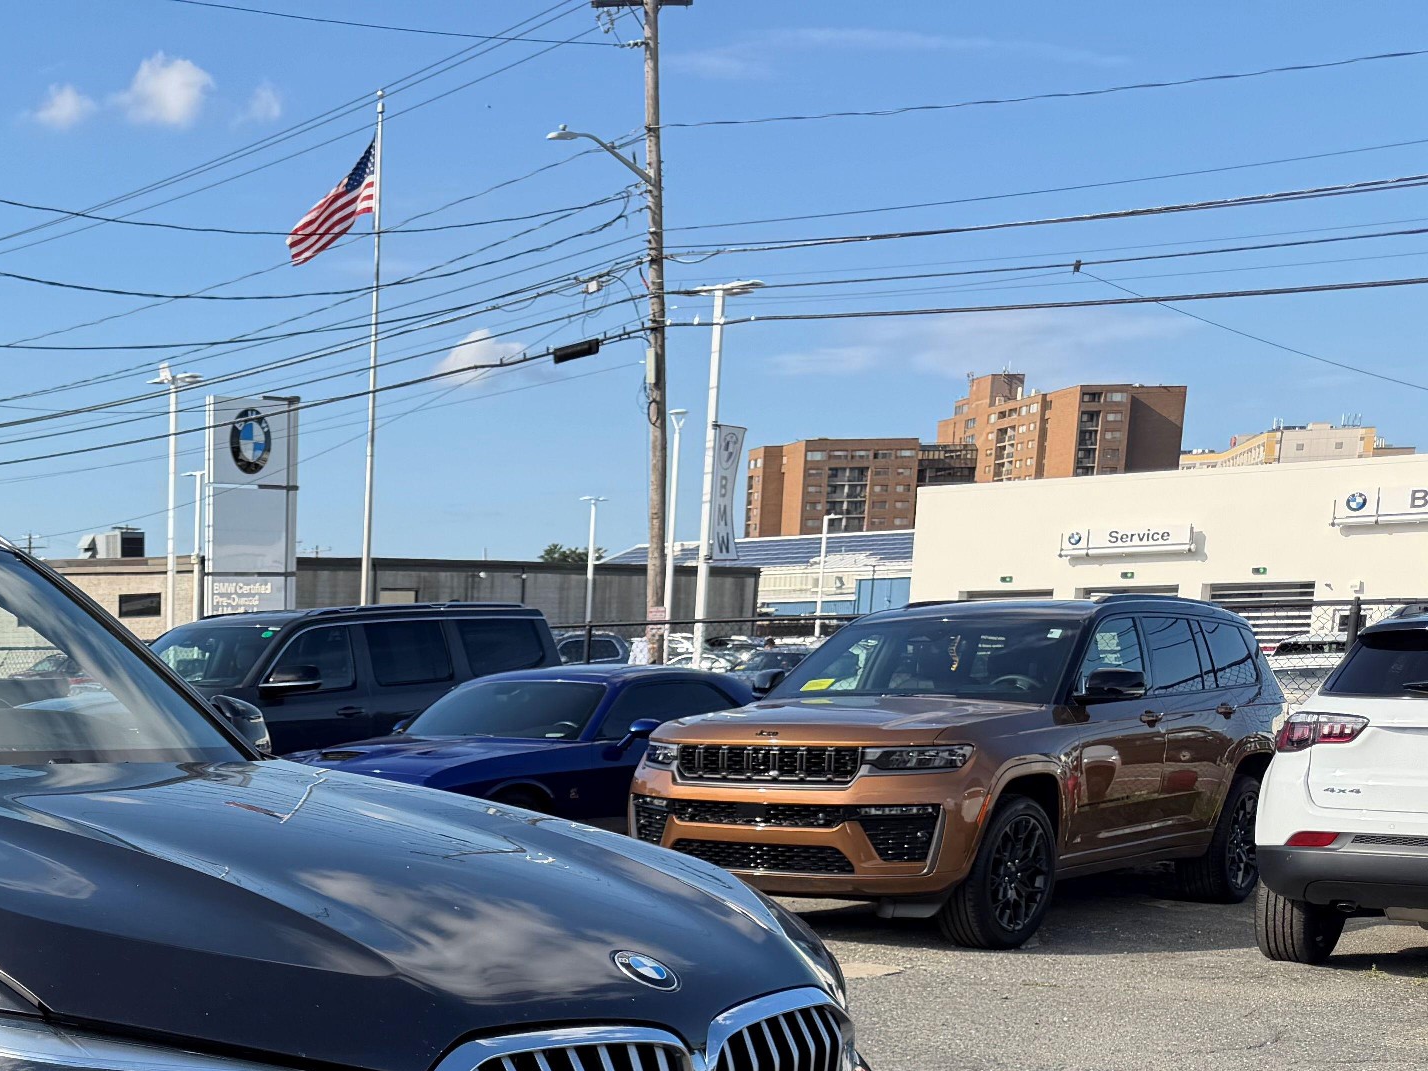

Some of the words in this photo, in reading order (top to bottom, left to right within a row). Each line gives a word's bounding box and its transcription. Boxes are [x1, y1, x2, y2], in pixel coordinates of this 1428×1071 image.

[717, 475, 730, 554] BMW
[1108, 529, 1171, 544] Service
[213, 583, 236, 594] BMW
[237, 582, 272, 594] Certified
